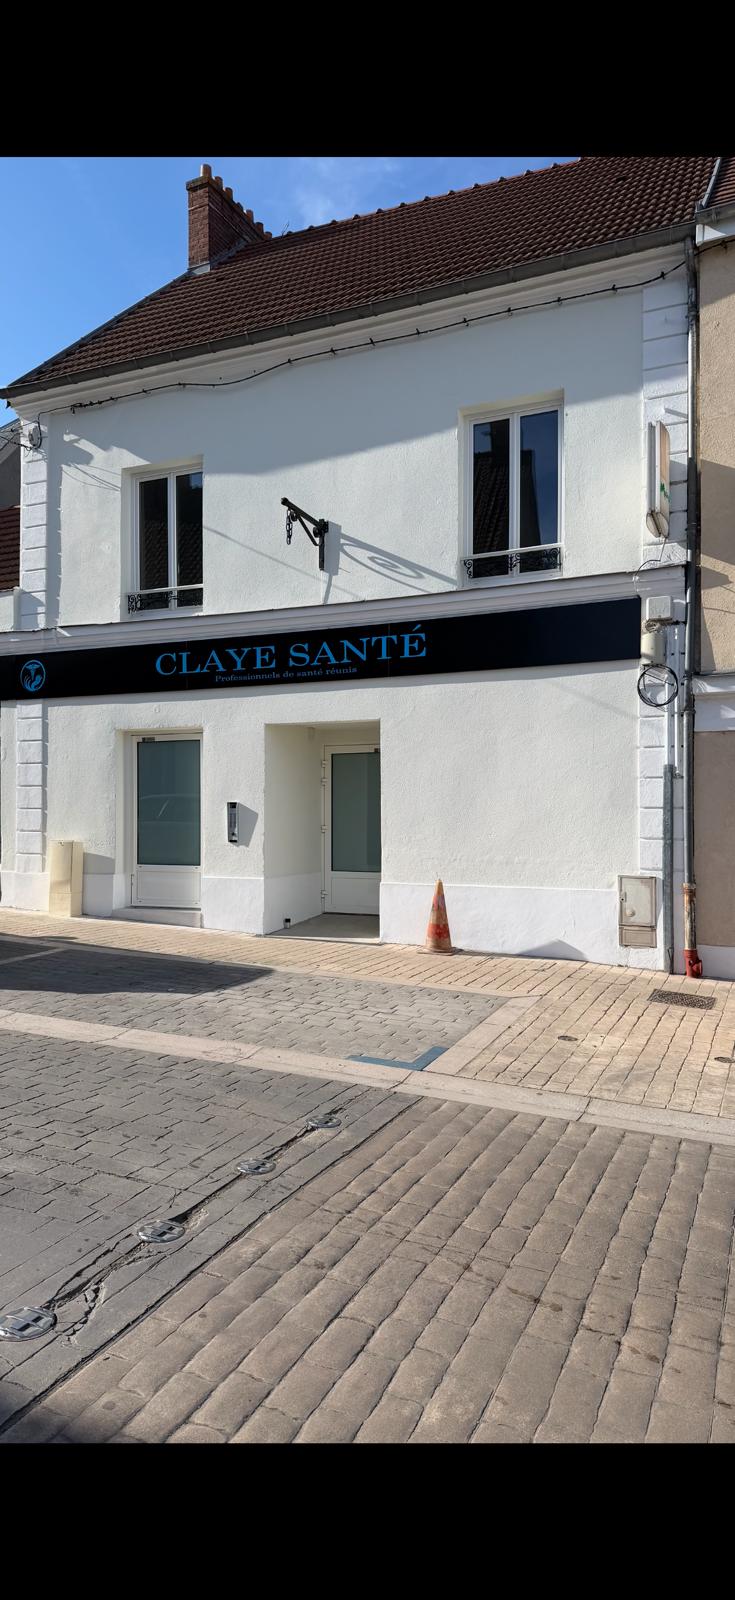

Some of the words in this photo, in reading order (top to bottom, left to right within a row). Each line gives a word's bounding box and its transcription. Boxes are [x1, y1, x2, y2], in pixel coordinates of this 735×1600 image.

[155, 645, 276, 676] CLAYE
[288, 624, 427, 667] SANTÉ
[215, 671, 280, 683] Professionnels
[282, 670, 295, 678] de
[296, 668, 323, 677] santé
[325, 666, 358, 676] réunis
